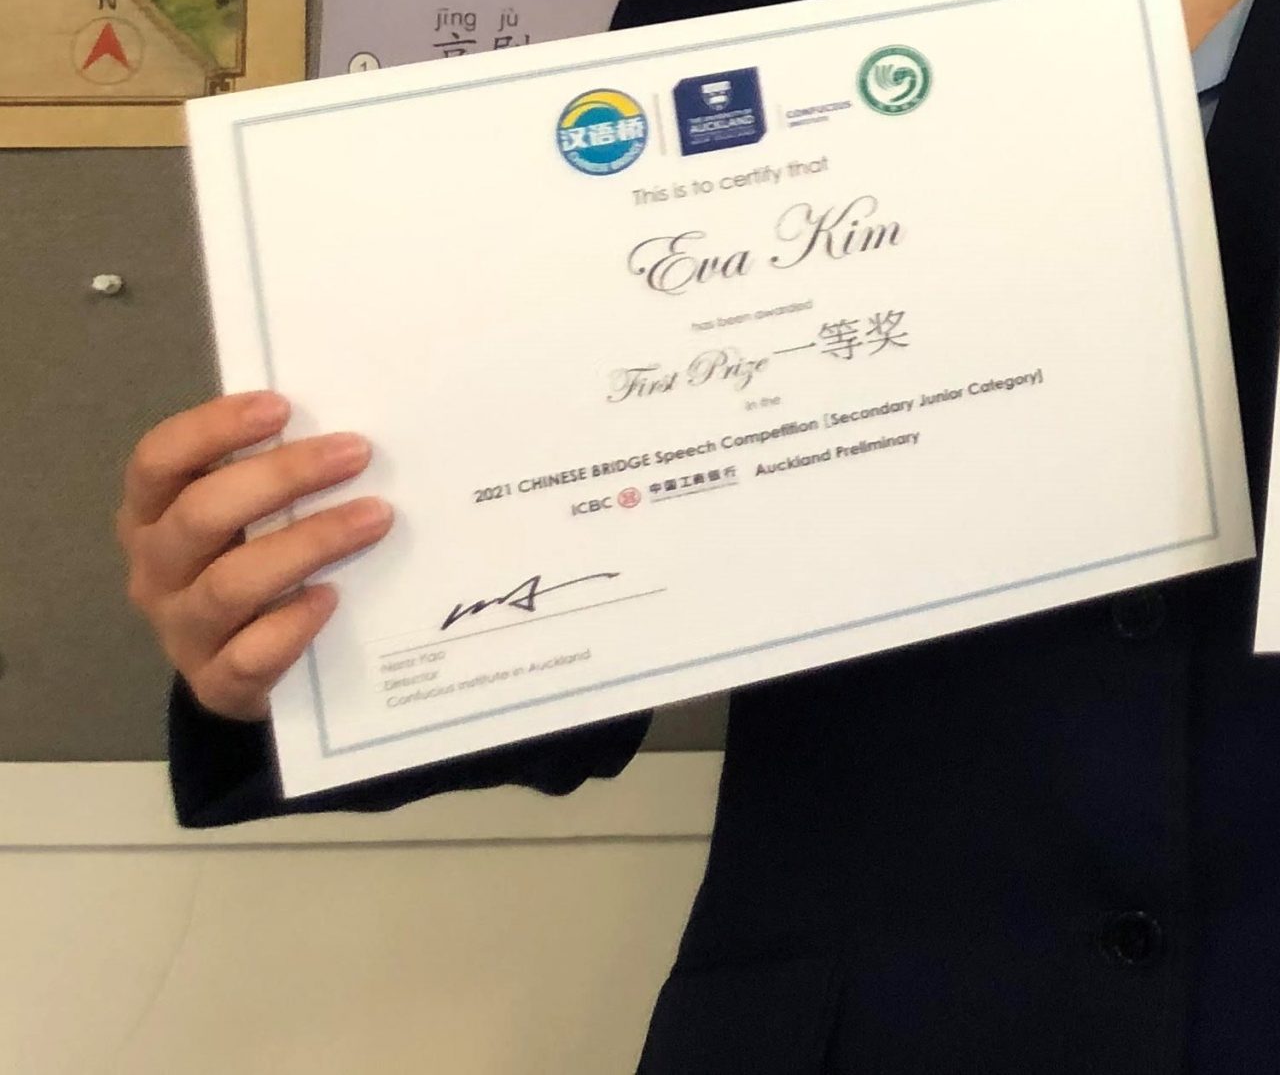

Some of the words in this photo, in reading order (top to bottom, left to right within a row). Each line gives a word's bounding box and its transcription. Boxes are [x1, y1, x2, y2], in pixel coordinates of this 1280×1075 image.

[632, 188, 669, 206] This
[674, 182, 688, 199] is
[692, 179, 714, 196] to
[719, 165, 781, 191] certify
[787, 156, 829, 177] that
[627, 230, 752, 296] Eva
[770, 195, 903, 269] Kim
[717, 313, 750, 327] been
[754, 299, 813, 320] awarded
[773, 310, 911, 360] 一等奖
[606, 363, 679, 403] First
[687, 346, 769, 392] Prize
[761, 394, 782, 408] the
[474, 485, 512, 503] 2021
[518, 467, 588, 494] CHINESE
[592, 453, 650, 478] BRIDGE
[655, 440, 717, 466] Speech
[720, 419, 819, 450] Competition
[823, 398, 914, 429] [Secondary
[919, 387, 964, 408] Junior
[967, 368, 1044, 397] Category]
[755, 449, 832, 477] Auckland
[836, 431, 920, 459] Preliminary
[571, 496, 613, 517] ICBC
[528, 648, 591, 673] Auckland
